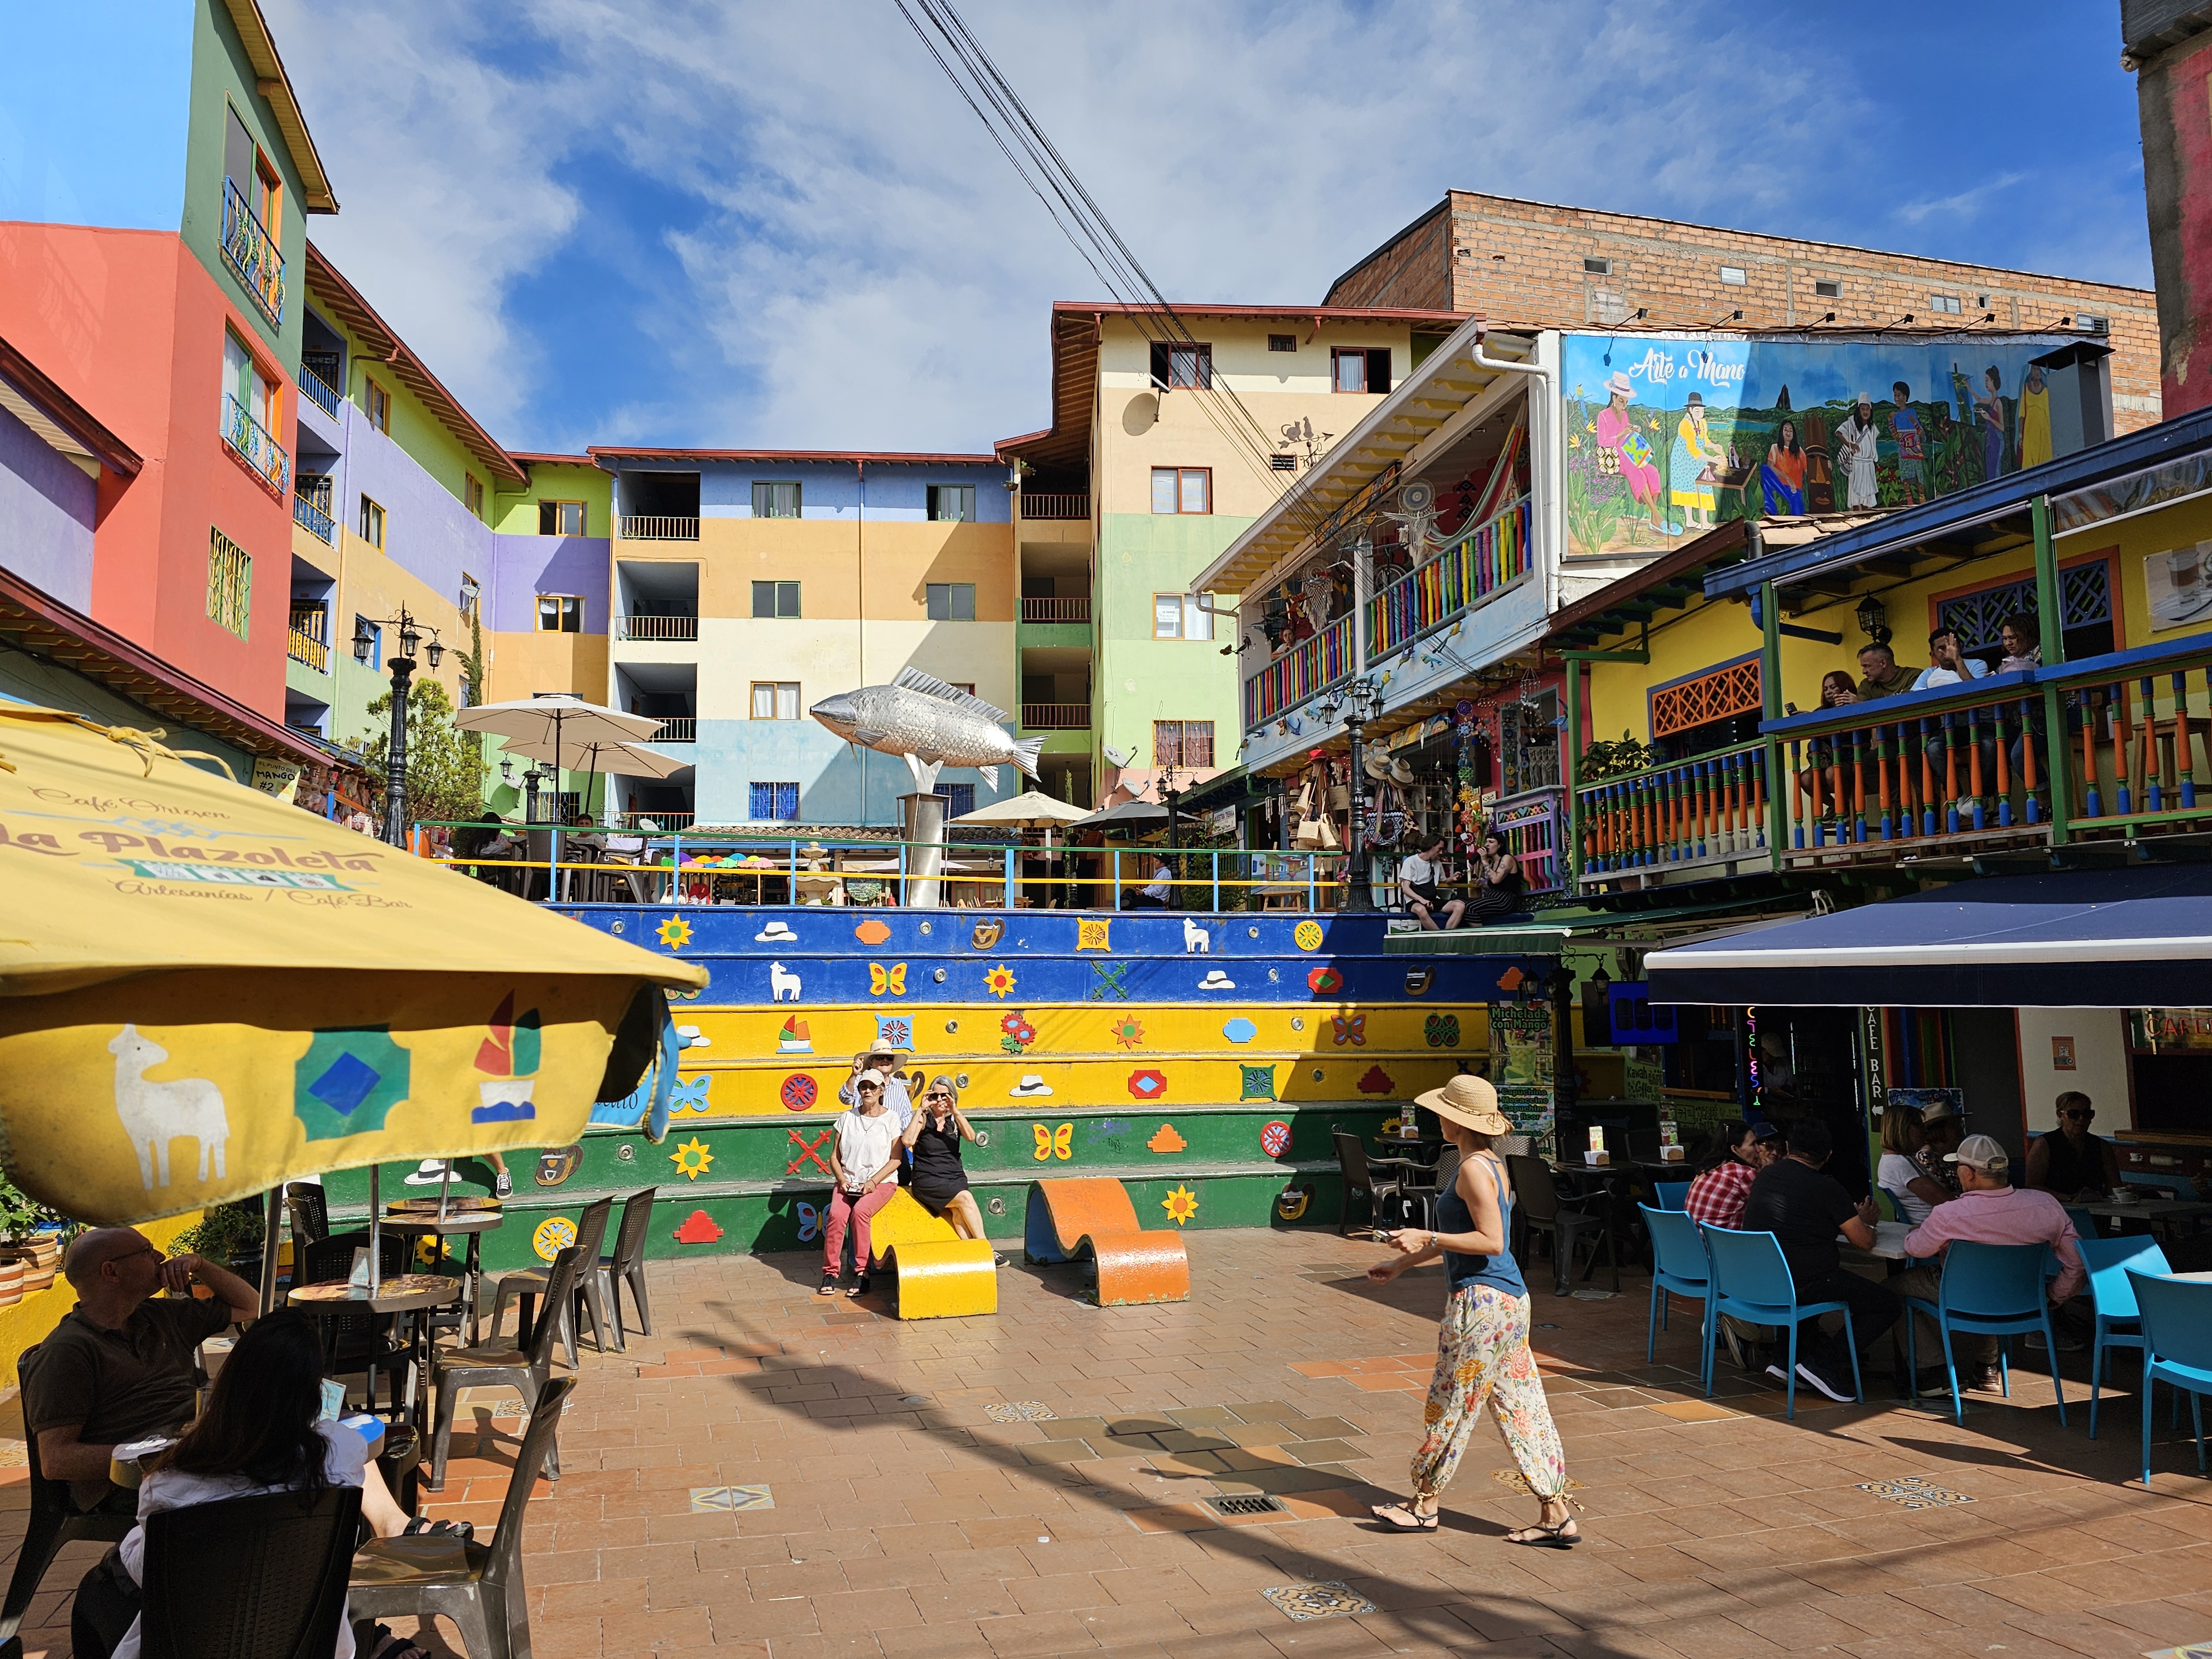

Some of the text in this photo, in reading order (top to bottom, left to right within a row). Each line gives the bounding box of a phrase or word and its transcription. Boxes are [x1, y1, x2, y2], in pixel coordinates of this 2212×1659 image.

[1629, 347, 1746, 388] Arte a Mano
[256, 770, 295, 781] MANGO
[259, 781, 274, 791] #2
[118, 797, 230, 819] Origen
[79, 831, 384, 872] Plazoleta
[347, 894, 413, 909] Bar
[1491, 1007, 1548, 1019] Michelada
[1514, 1019, 1547, 1031] Mango
[2146, 1018, 2212, 1036] CAFE
[1870, 1059, 1882, 1098] BAR
[1502, 1104, 1547, 1113] Capuchino
